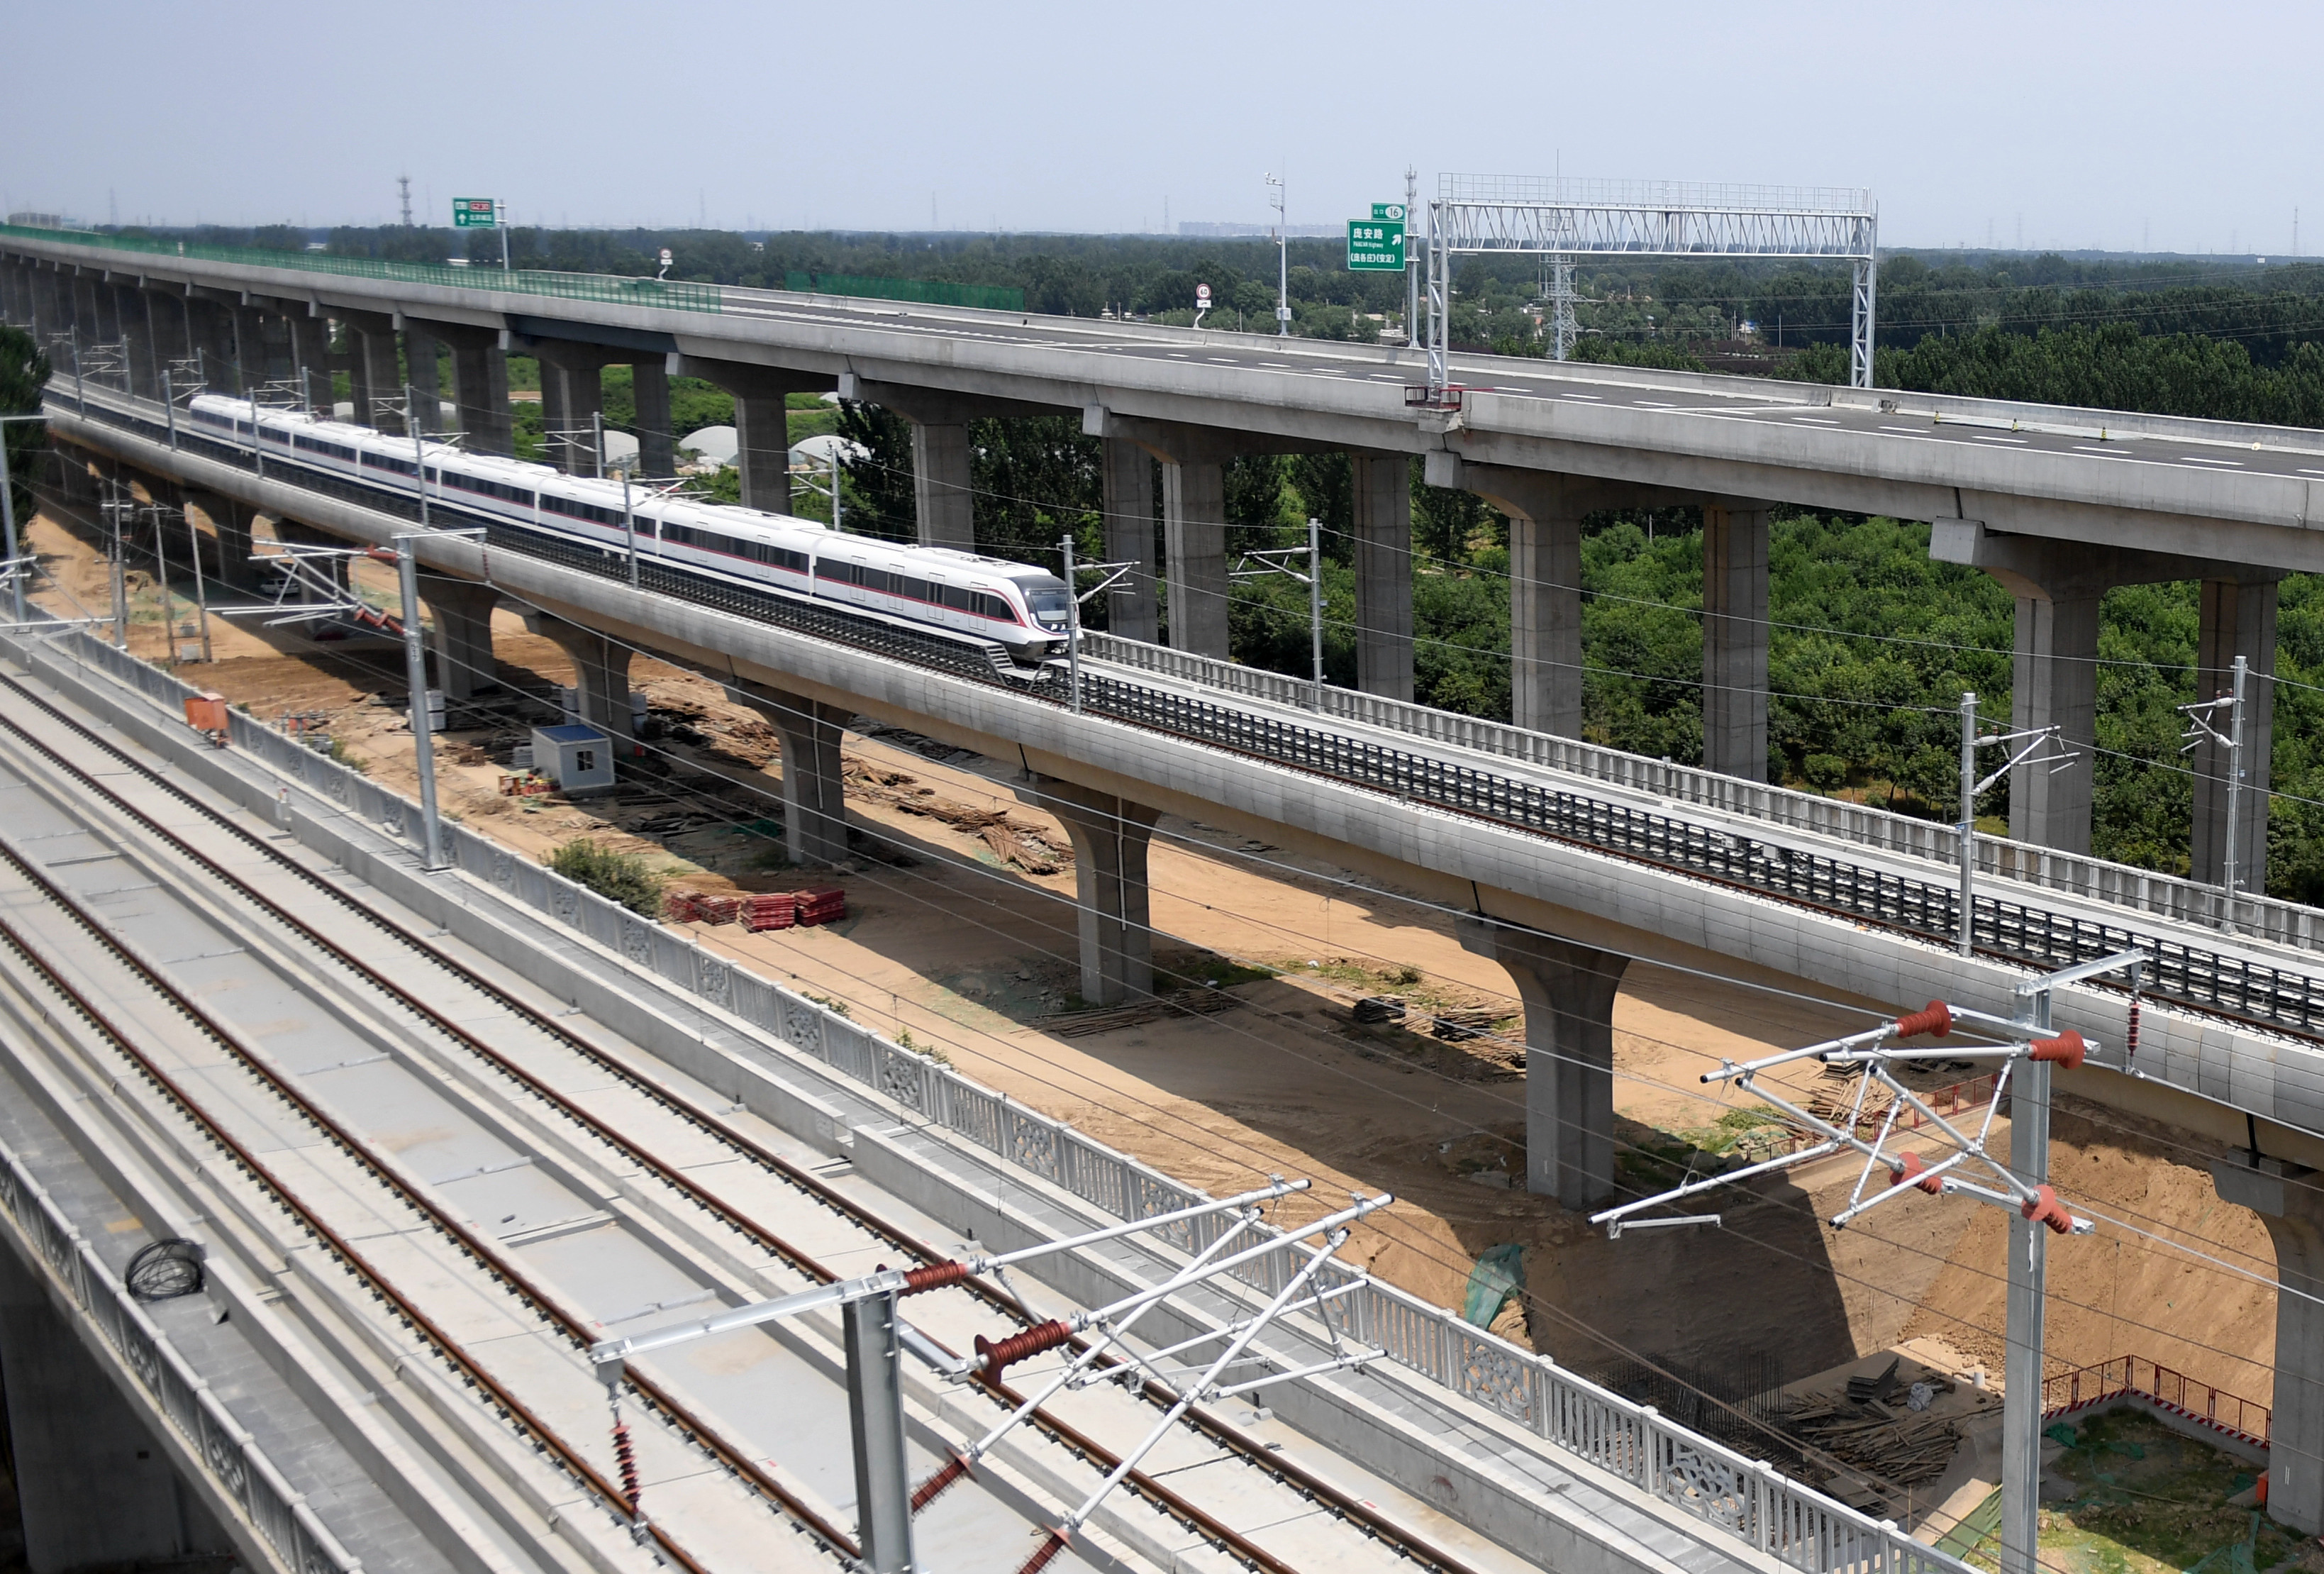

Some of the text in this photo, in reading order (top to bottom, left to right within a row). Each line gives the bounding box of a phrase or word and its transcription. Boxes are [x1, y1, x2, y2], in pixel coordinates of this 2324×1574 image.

[1389, 208, 1399, 217] 16
[1353, 228, 1384, 240] 庞安路
